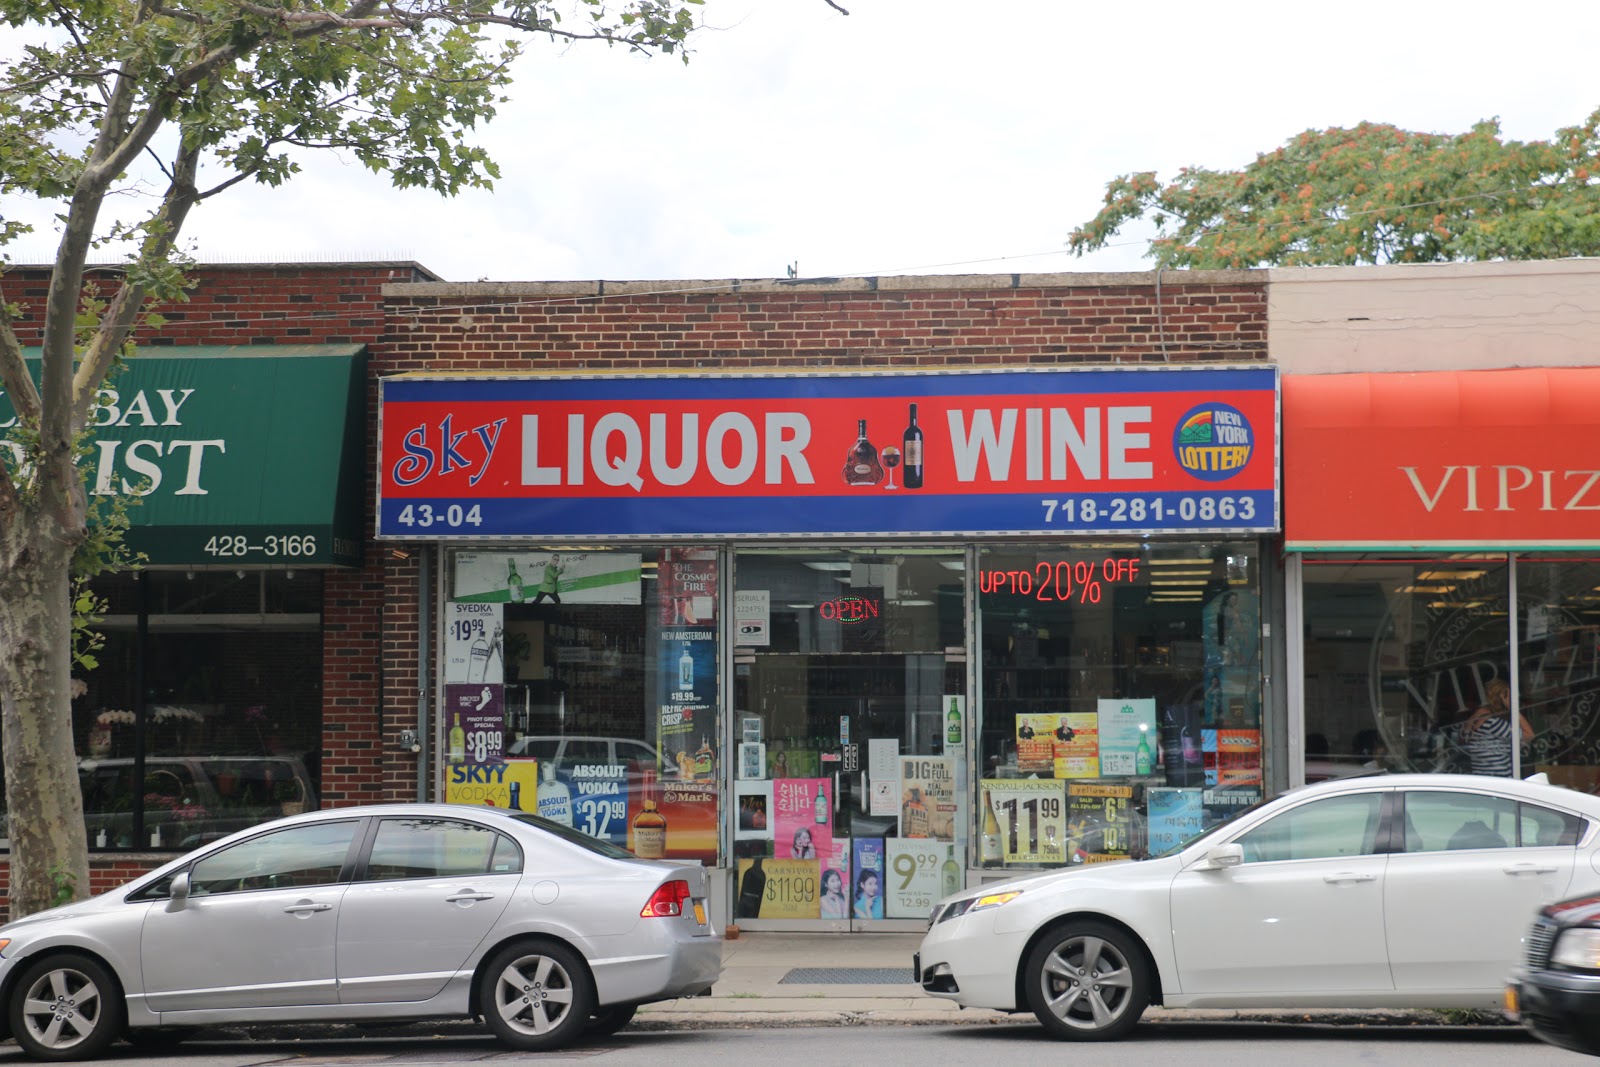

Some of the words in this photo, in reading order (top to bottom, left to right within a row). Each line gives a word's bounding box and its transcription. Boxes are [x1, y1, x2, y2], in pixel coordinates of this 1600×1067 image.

[1214, 410, 1242, 427] NEW
[1215, 425, 1248, 444] YORK
[392, 413, 507, 487] Sky
[521, 411, 815, 492] LIQUOR
[946, 406, 1153, 482] WINE
[1179, 445, 1251, 471] LOTTERY
[398, 504, 482, 527] 43-04
[1042, 496, 1255, 522] 718-281-0863
[204, 535, 316, 556] 428-3166
[675, 572, 714, 581] COSMIC
[1036, 561, 1100, 604] 20%
[1103, 558, 1140, 582] OFF
[683, 582, 706, 591] FIRE
[456, 604, 493, 613] SVEDKA
[819, 599, 879, 620] OPEN
[661, 631, 675, 640] NEW
[675, 631, 712, 640] AMSTERDAM
[662, 713, 682, 726] CRISP
[452, 764, 509, 784] SKYY
[573, 765, 625, 778] ABSOLUT
[904, 761, 931, 779] BIG
[451, 787, 508, 800] VODKA
[578, 782, 619, 794] VODKA
[664, 783, 713, 792] Maker's
[1076, 785, 1105, 795] yellow
[538, 797, 567, 808] ABSOLUT
[678, 793, 712, 802] Mark
[541, 807, 567, 817] VODKA
[766, 877, 815, 903] $11.99
